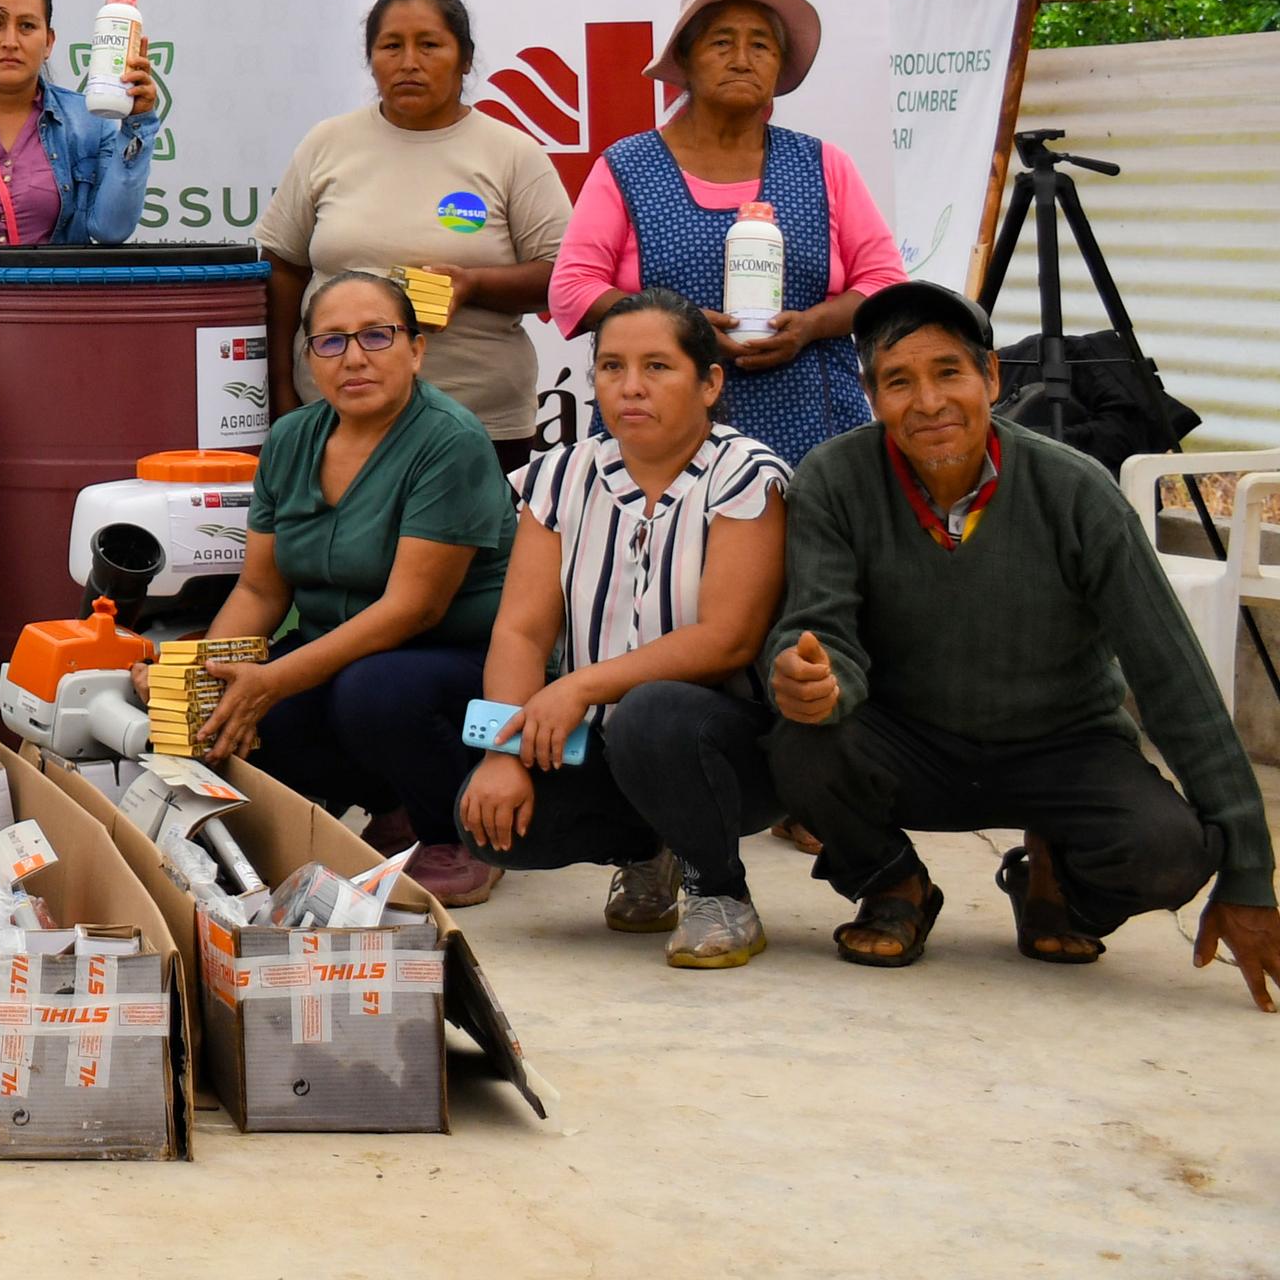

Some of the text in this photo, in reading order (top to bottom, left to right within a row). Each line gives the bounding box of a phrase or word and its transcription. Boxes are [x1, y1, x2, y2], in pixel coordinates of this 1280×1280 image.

[897, 88, 958, 113] CUMBRE
[312, 962, 388, 982] STIHL
[34, 1006, 110, 1023] STIHL
